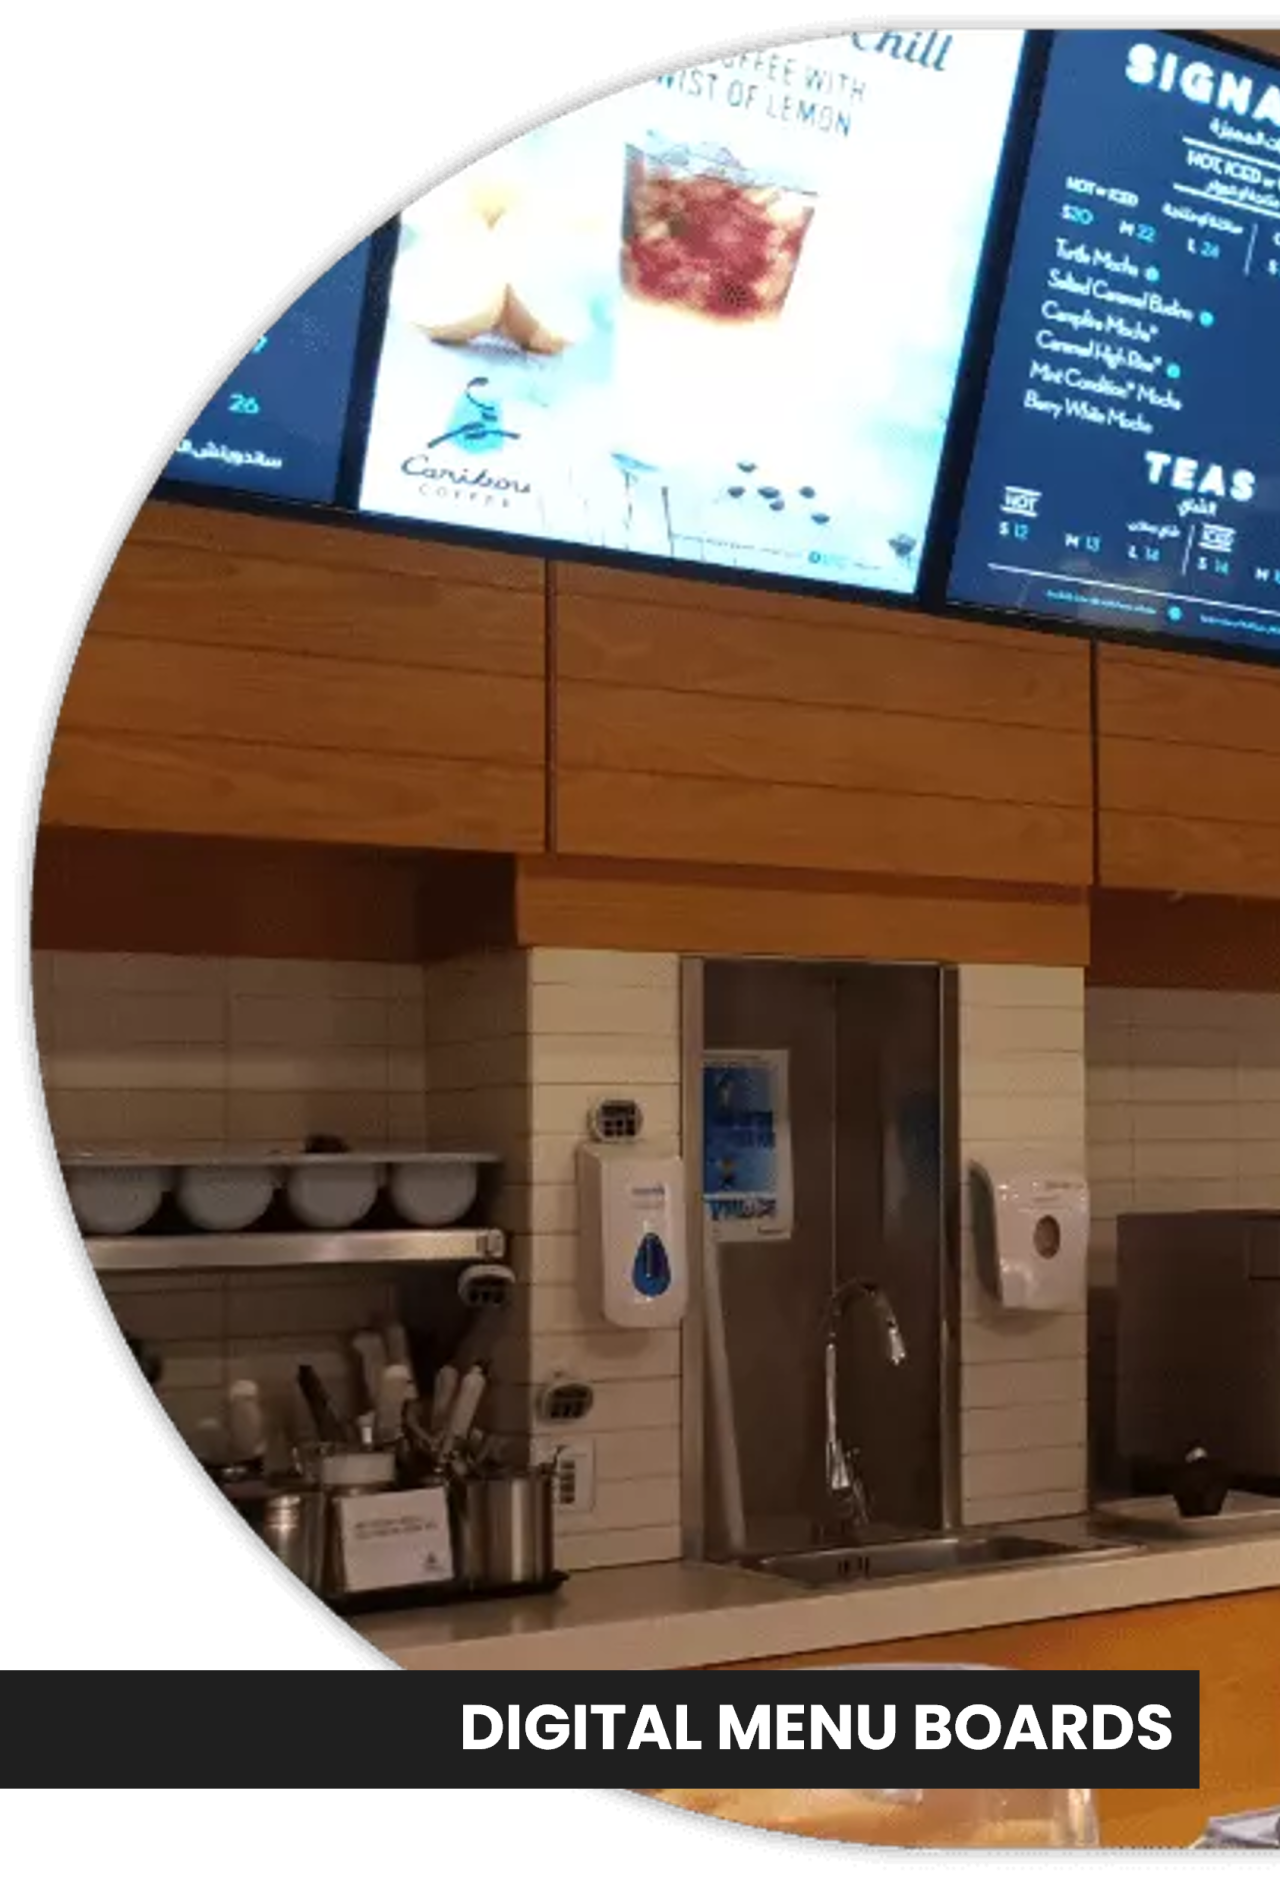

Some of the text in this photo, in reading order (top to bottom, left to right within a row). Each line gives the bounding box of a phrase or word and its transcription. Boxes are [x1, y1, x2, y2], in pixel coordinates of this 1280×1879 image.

[806, 68, 866, 106] WITH
[727, 79, 758, 109] OF
[765, 94, 851, 137] LEMON
[1065, 175, 1096, 195] HOT
[1223, 159, 1262, 186] ICED
[1118, 219, 1134, 238] M
[1092, 249, 1139, 280] Mocha
[228, 394, 260, 414] 26
[1105, 408, 1155, 436] Mocha
[401, 453, 531, 493] Caribou
[1144, 449, 1257, 502] TEAS
[1064, 532, 1081, 548] M
